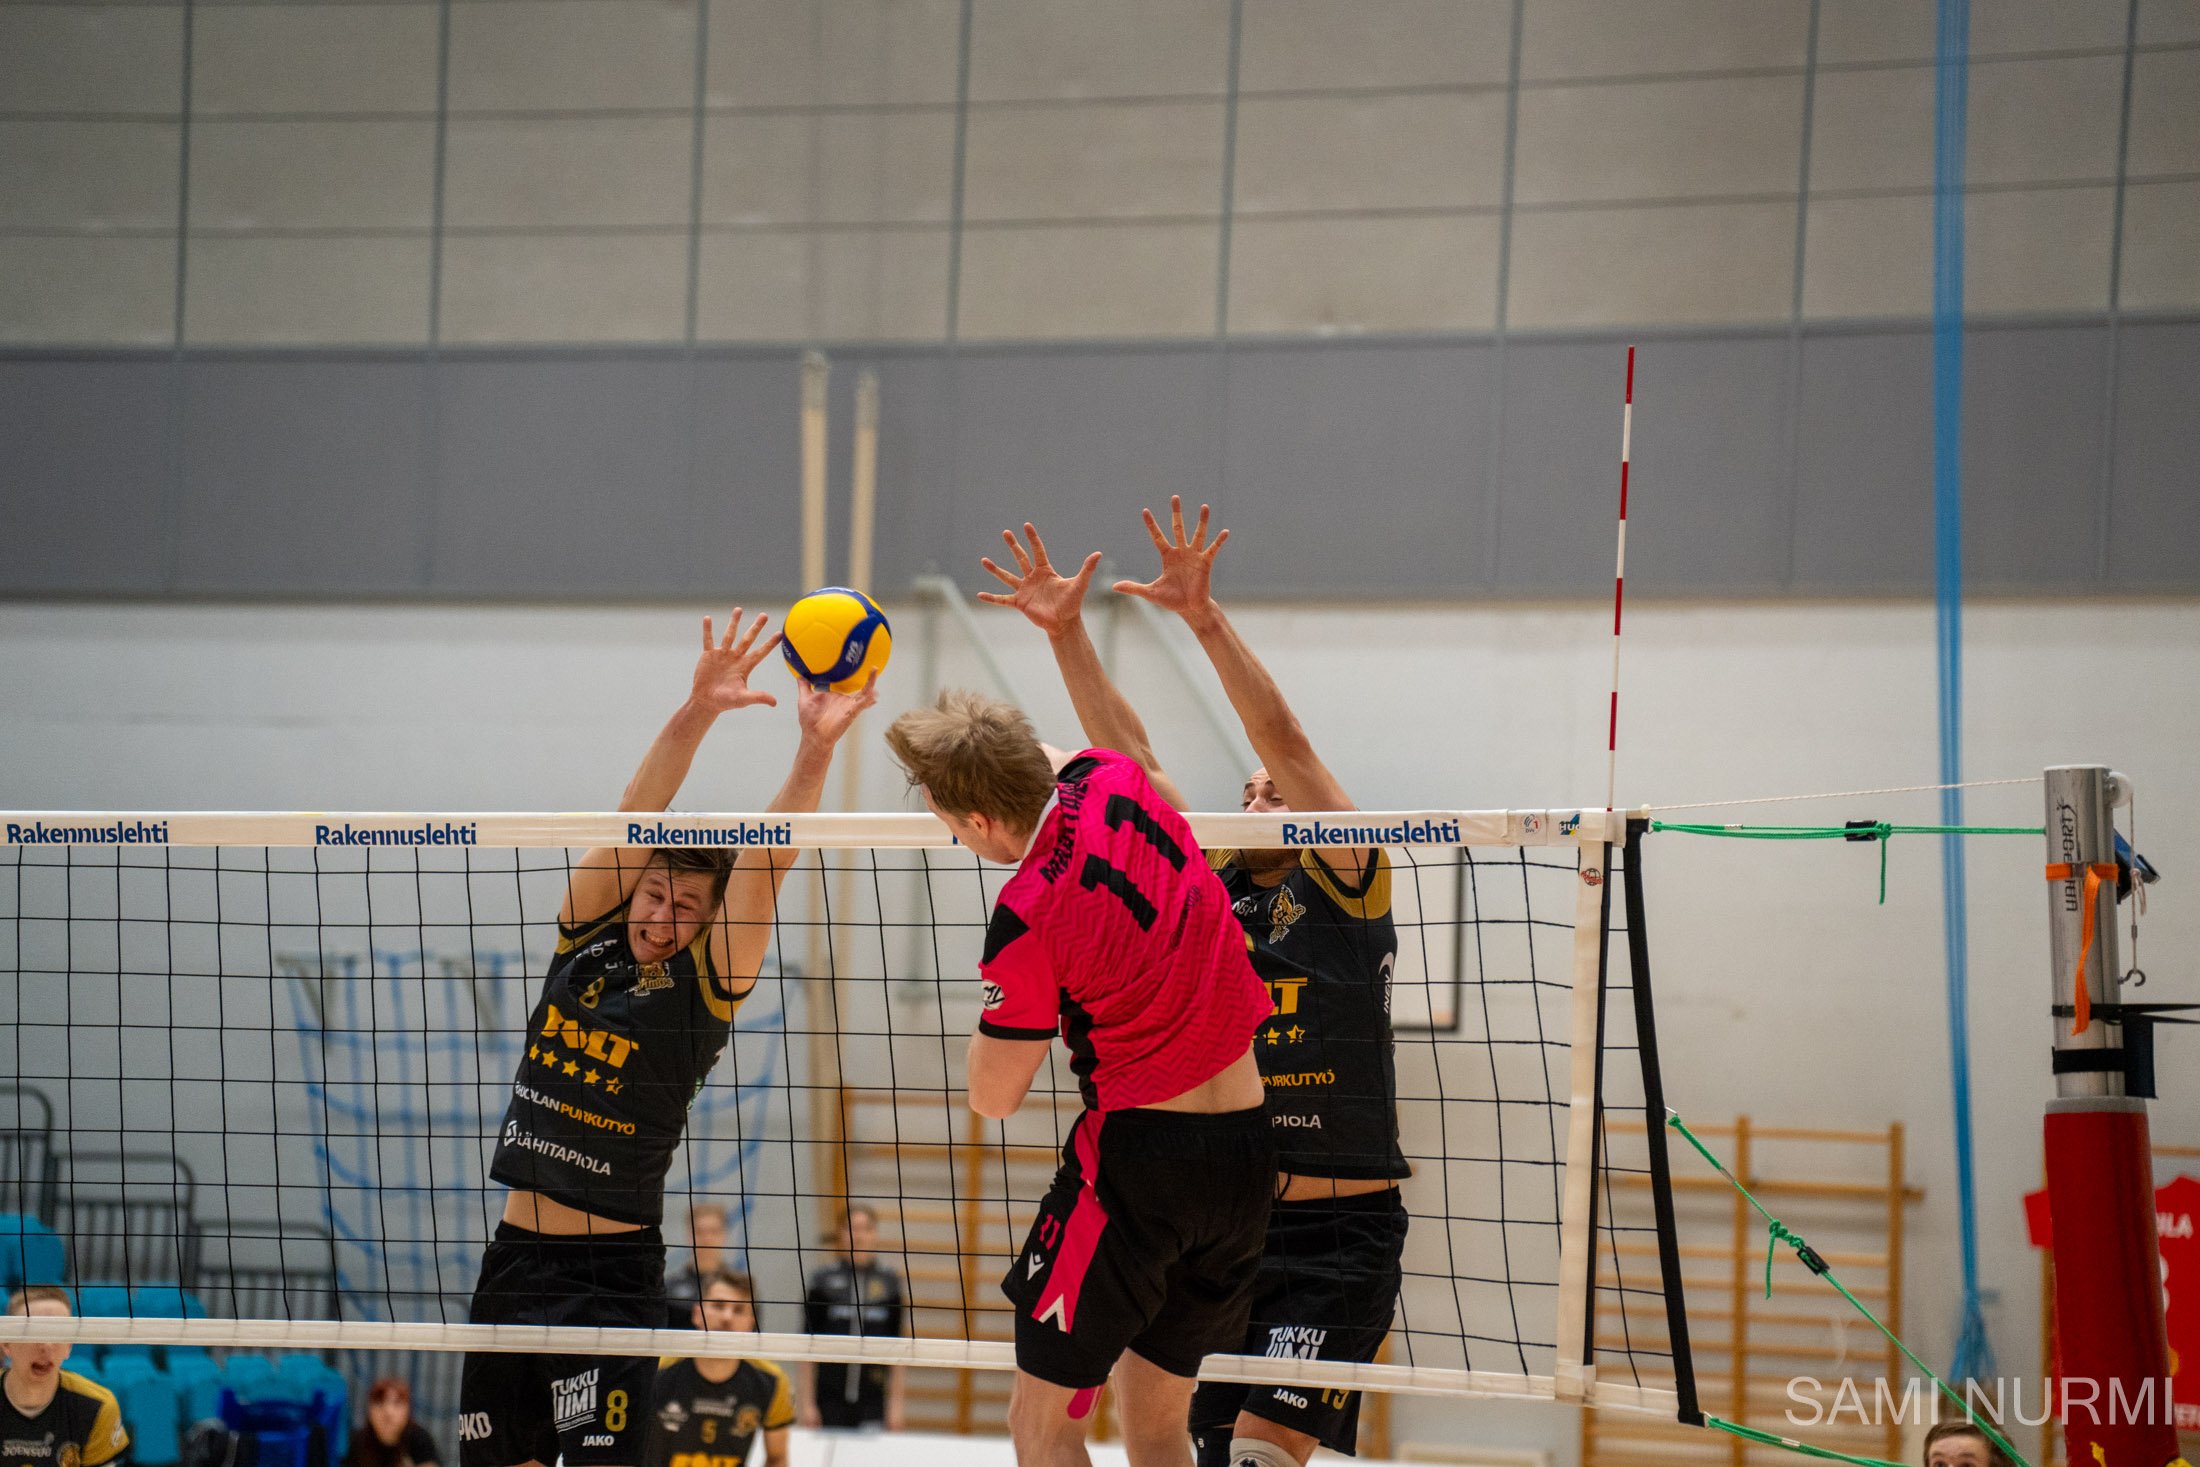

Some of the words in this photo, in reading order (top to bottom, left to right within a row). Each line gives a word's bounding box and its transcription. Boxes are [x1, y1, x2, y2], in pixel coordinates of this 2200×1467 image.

[7, 821, 168, 844] Rakennuslehti
[316, 823, 477, 845] Rakennuslehti
[628, 822, 791, 845] Rakennuslehti
[1283, 819, 1461, 845] Rakennuslehti
[1079, 794, 1188, 933] 11
[579, 977, 605, 1009] 8
[517, 1131, 611, 1176] LÄHITAPIOLA
[551, 1368, 600, 1396] TUKKU
[605, 1389, 629, 1432] 8
[1273, 1388, 1308, 1409] JAKO
[582, 1435, 615, 1447] JAKO
